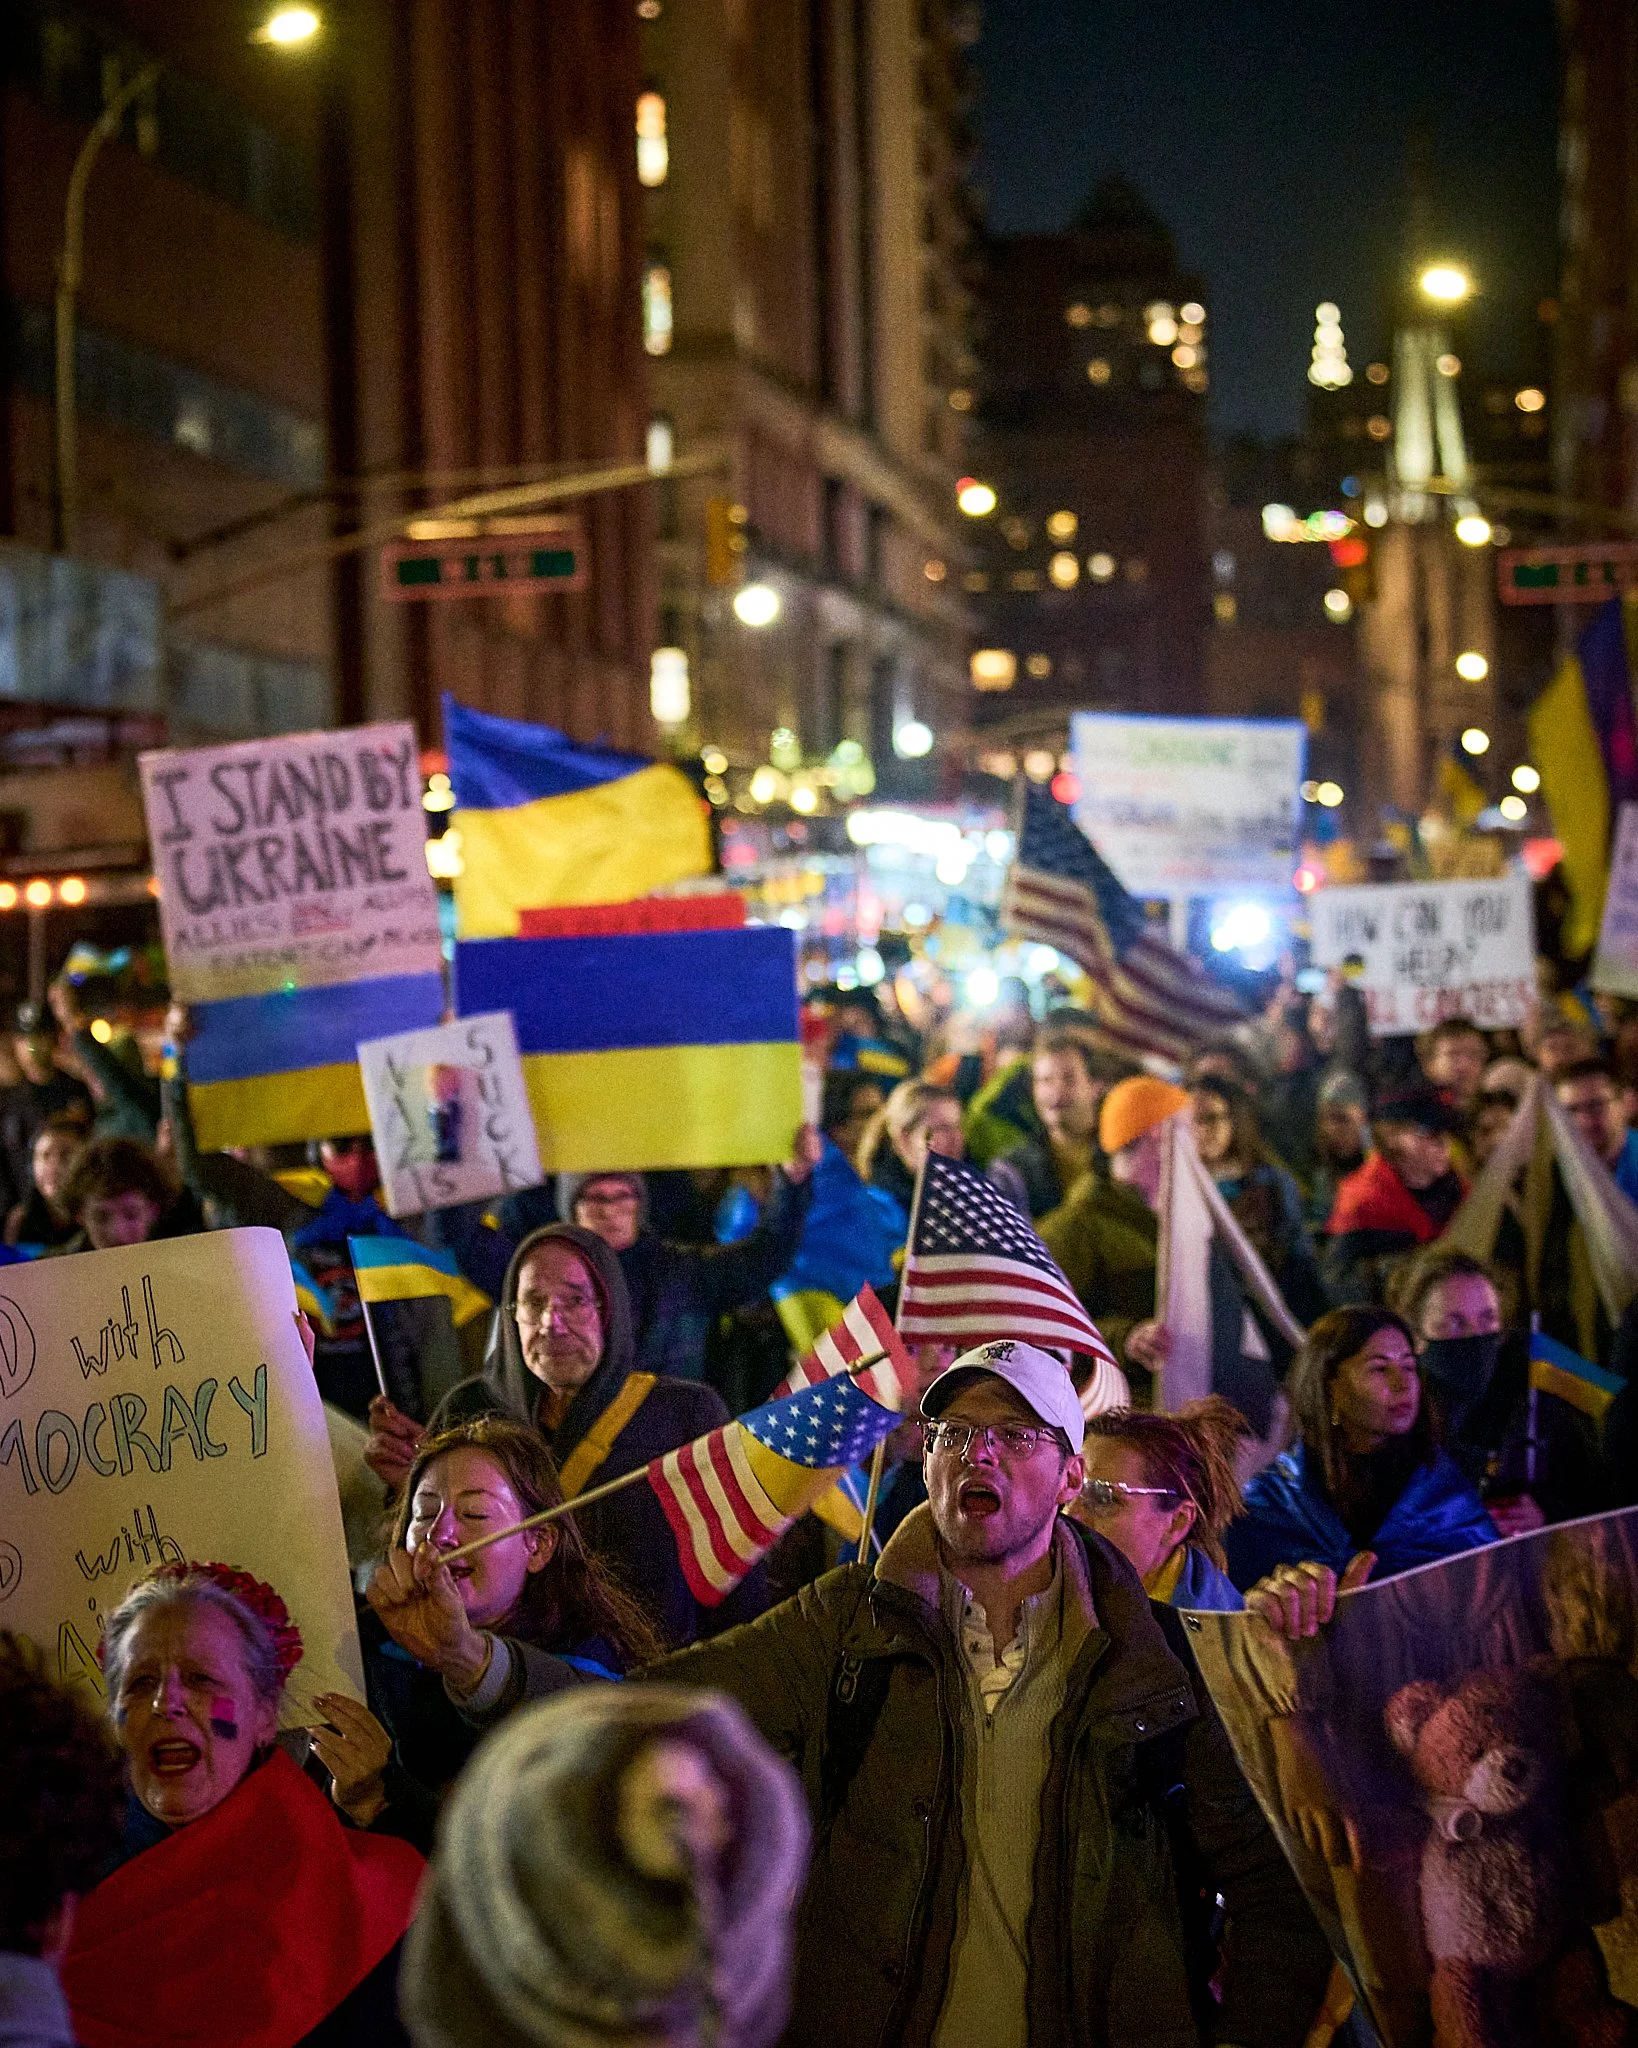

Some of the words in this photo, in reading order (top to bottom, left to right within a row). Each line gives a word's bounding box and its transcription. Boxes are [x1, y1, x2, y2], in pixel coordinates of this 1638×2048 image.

[154, 769, 193, 846] I
[210, 752, 353, 834] STAND
[357, 741, 412, 812] BY
[173, 820, 408, 916] UKRAINE
[70, 1274, 185, 1379] with
[75, 1503, 187, 1581] with
